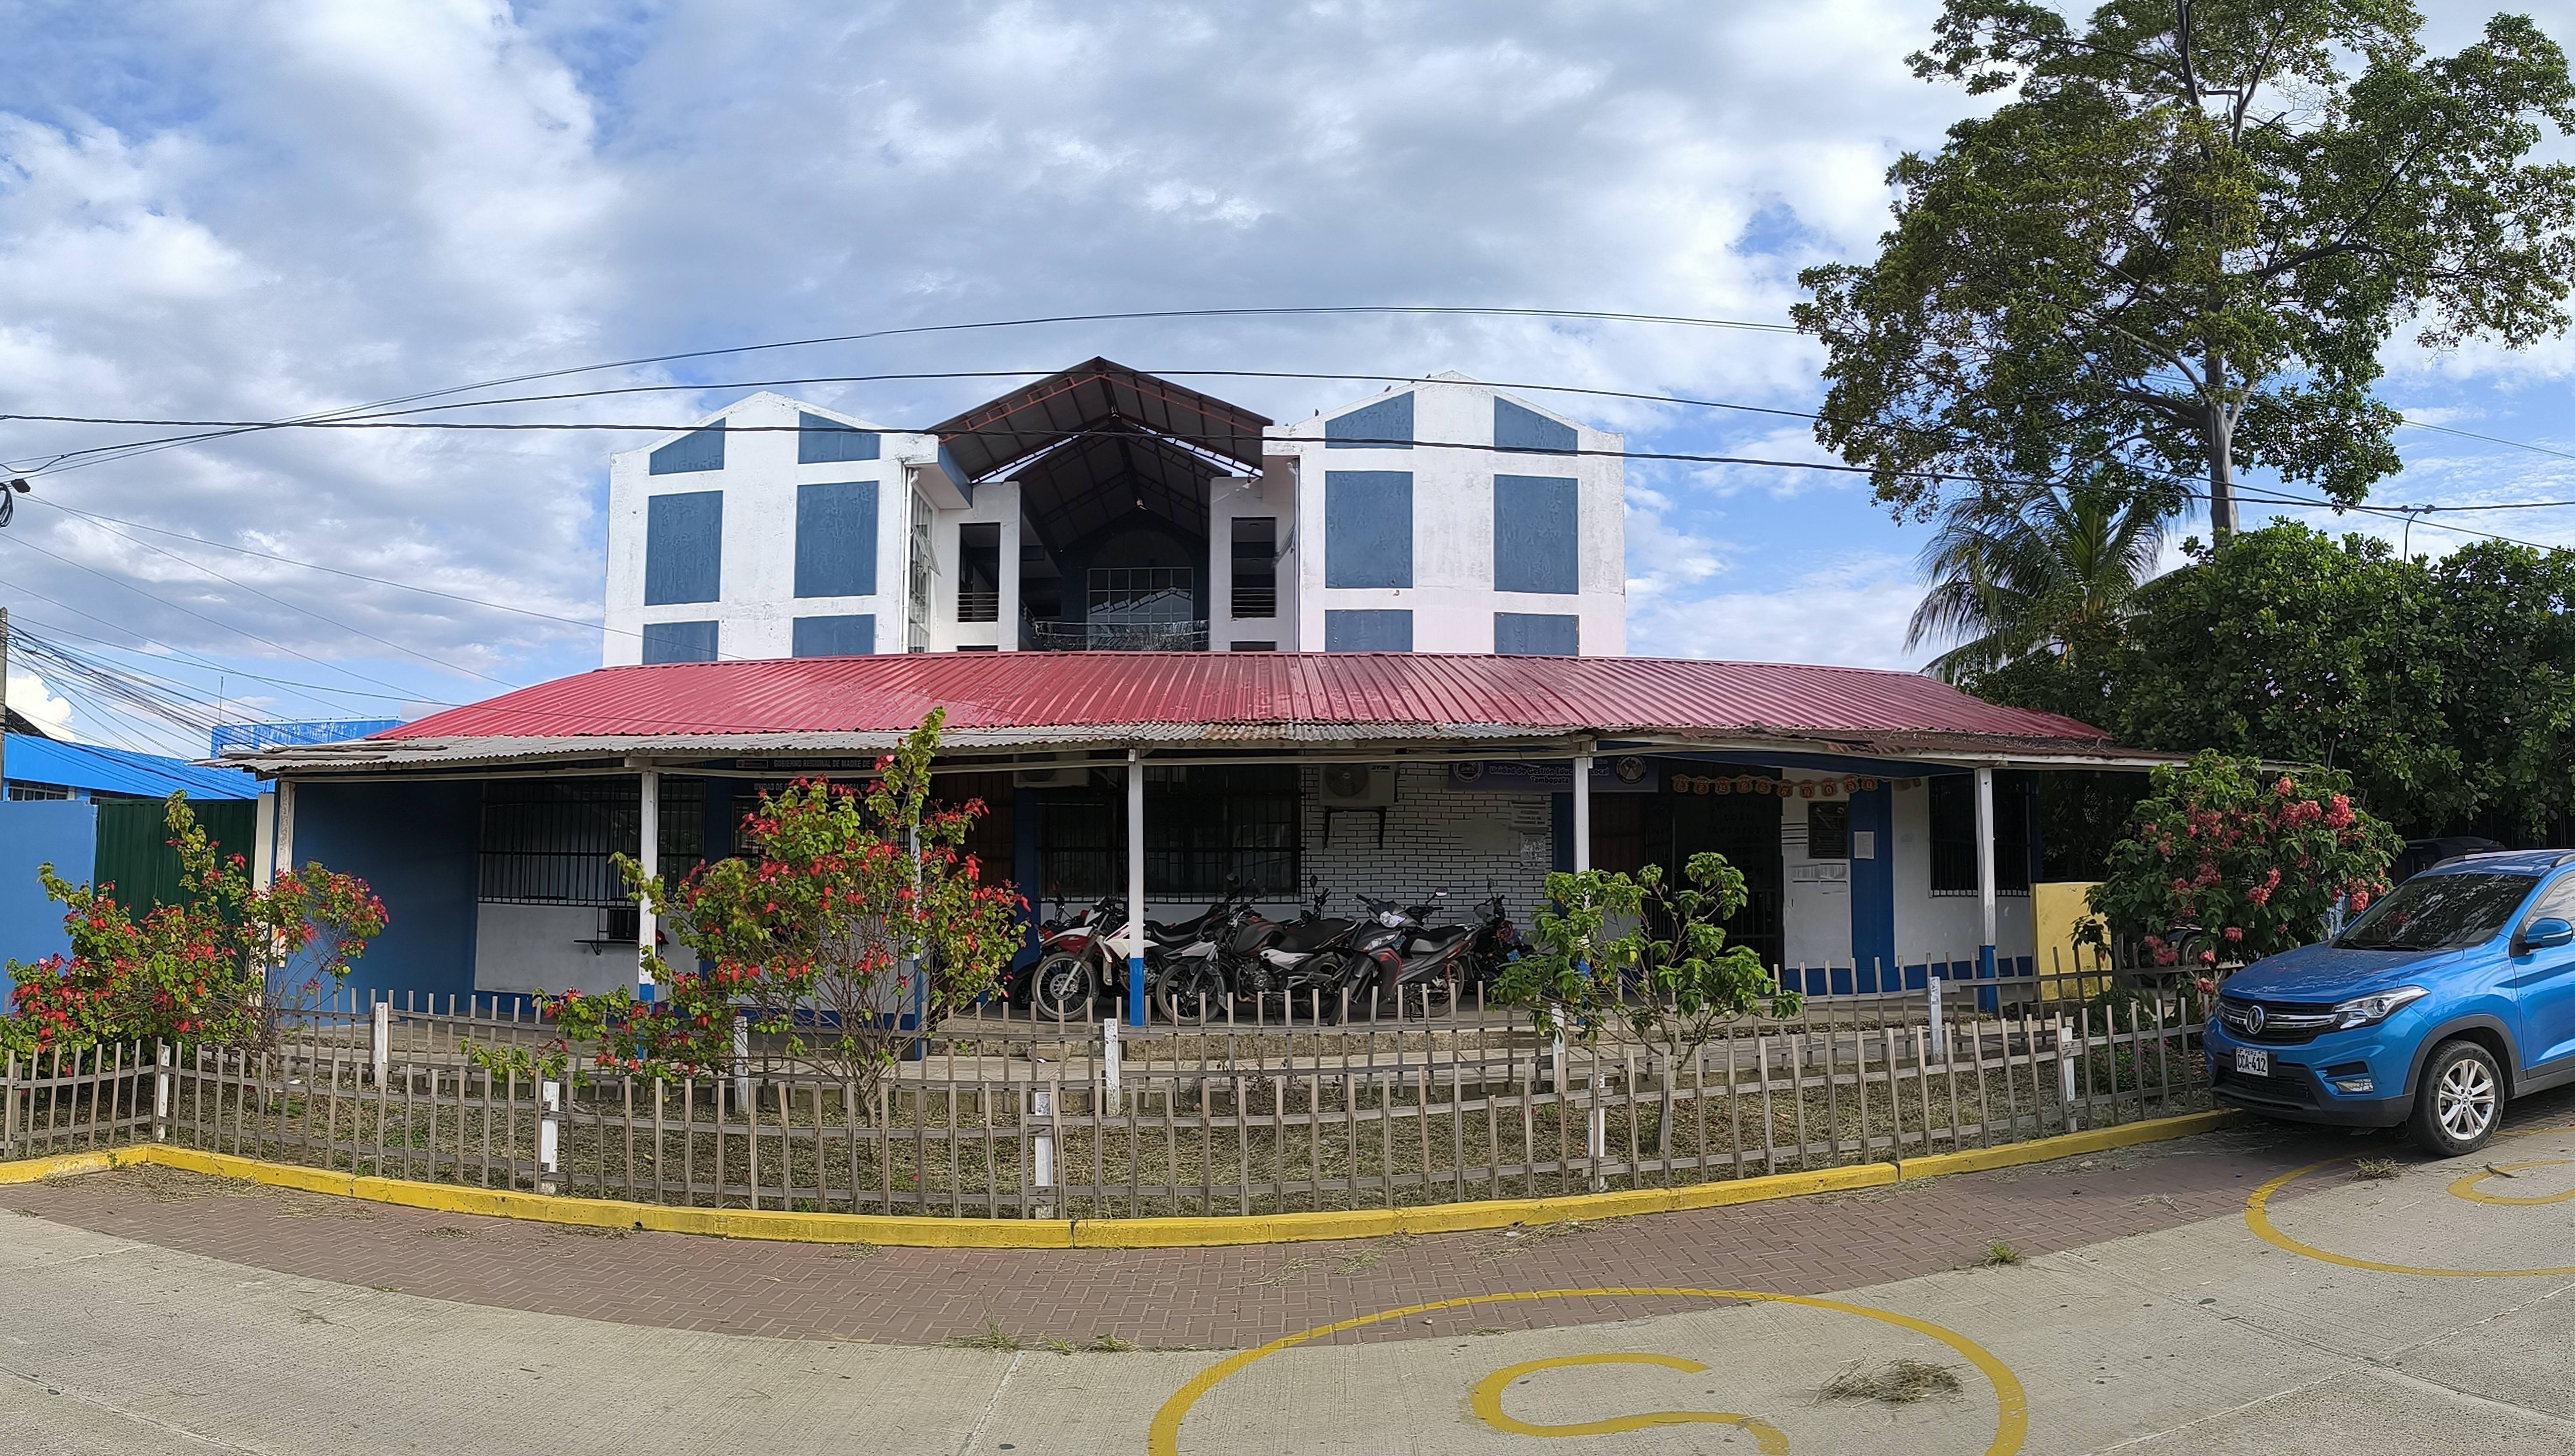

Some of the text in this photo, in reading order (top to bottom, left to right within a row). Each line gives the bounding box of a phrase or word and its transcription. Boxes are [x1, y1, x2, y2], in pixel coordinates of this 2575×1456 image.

[1490, 766, 1516, 774] Unidad
[1527, 766, 1554, 775] Gestión
[1531, 776, 1569, 784] Tambopata
